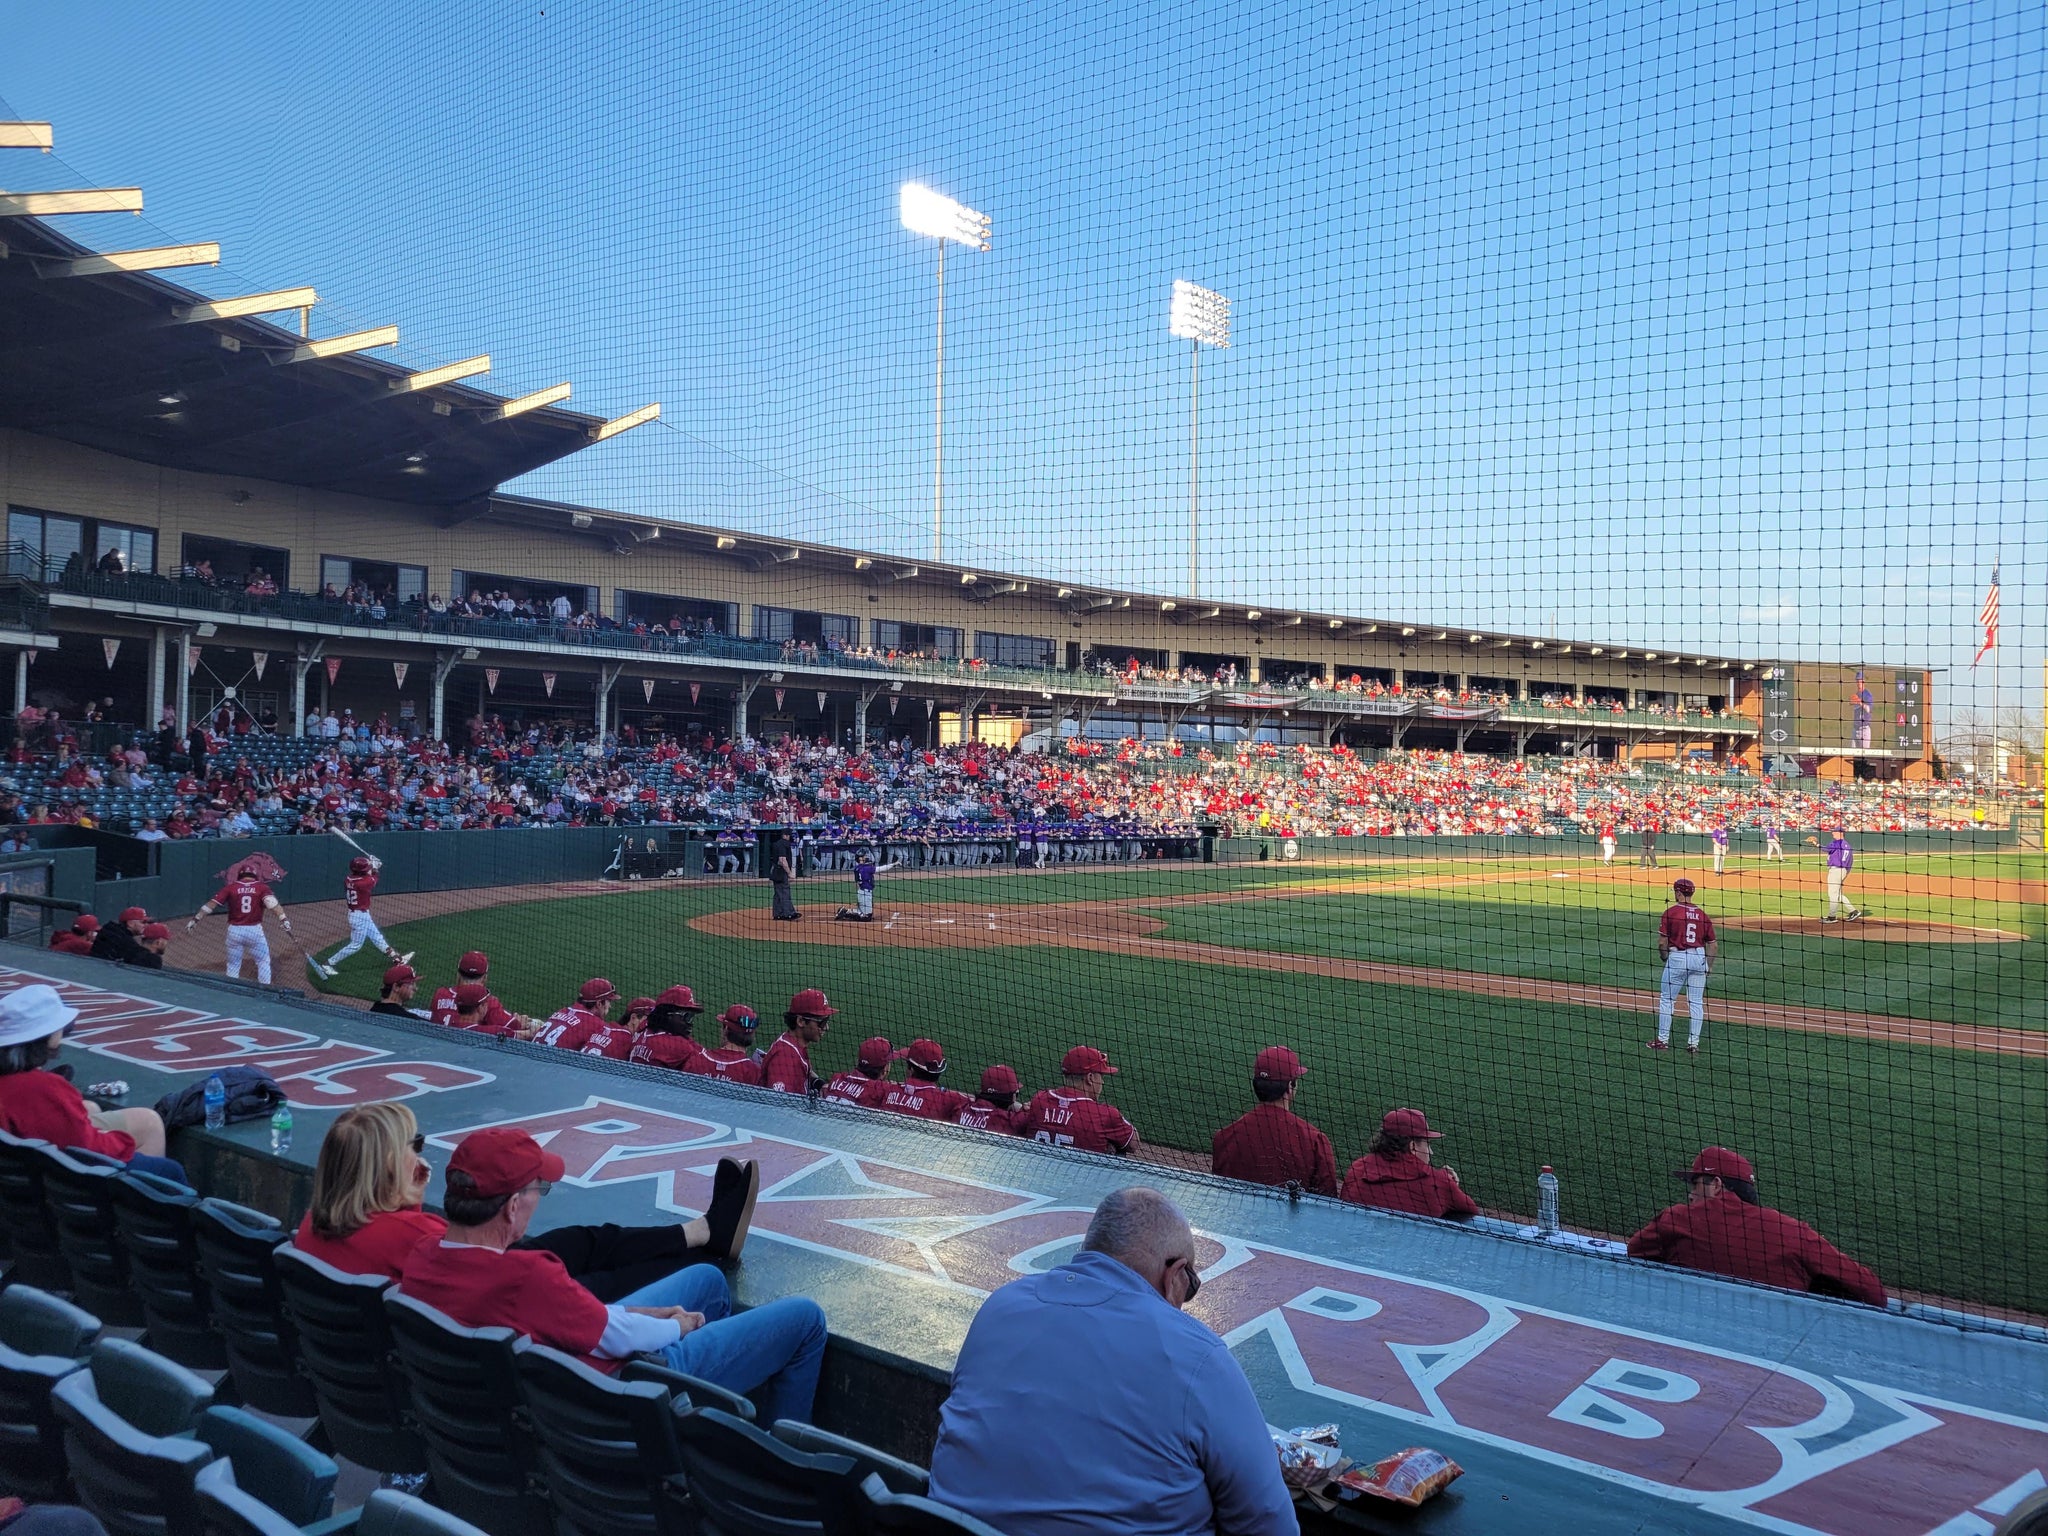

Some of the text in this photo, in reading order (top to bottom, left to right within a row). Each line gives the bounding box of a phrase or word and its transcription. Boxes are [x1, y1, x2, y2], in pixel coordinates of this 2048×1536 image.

[241, 895, 252, 913] 8
[1686, 923, 1697, 943] 6
[886, 1092, 924, 1110] HOLLAND
[959, 1112, 990, 1129] WILLIS
[1044, 1108, 1074, 1126] ALOY
